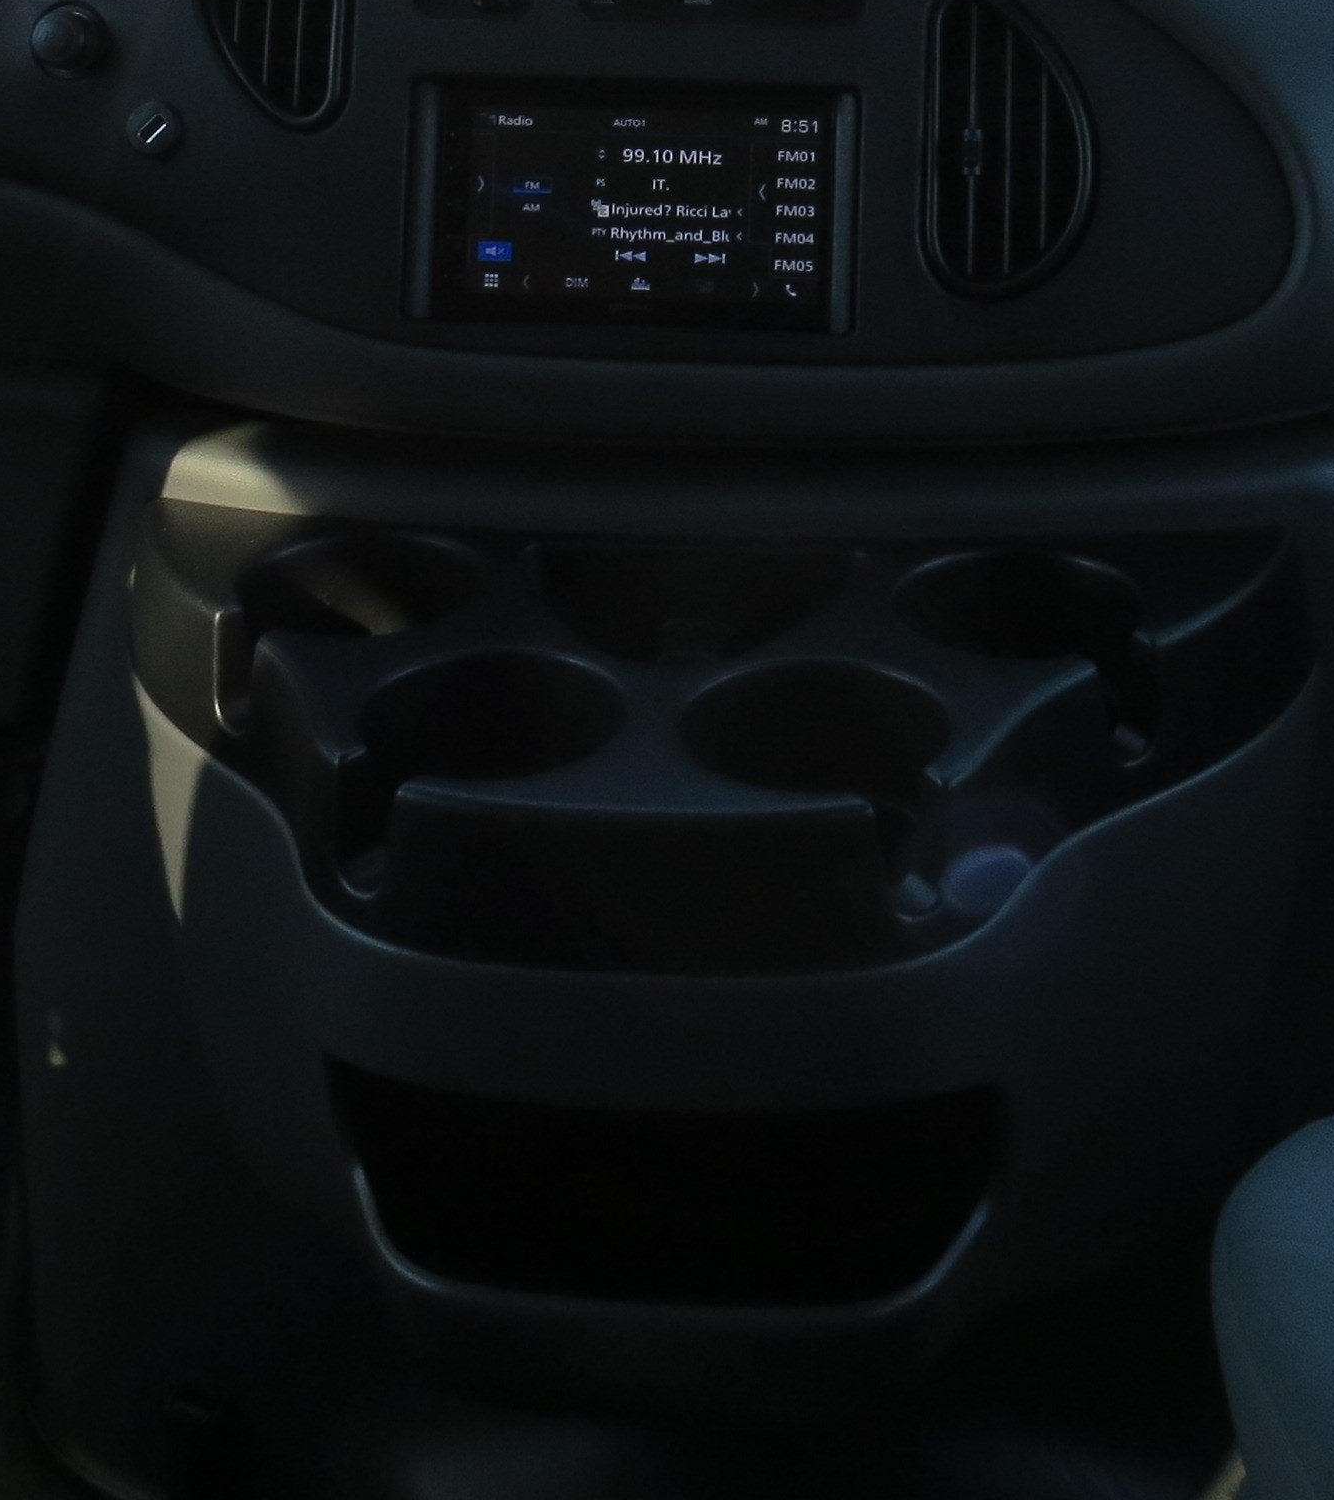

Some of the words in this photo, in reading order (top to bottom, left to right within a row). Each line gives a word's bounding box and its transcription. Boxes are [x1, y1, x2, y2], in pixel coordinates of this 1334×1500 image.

[498, 114, 534, 127] Radio
[780, 118, 820, 134] 8:51
[622, 148, 674, 164] 99.10
[679, 149, 724, 167] MHz
[777, 150, 817, 162] FM01
[776, 178, 816, 191] FM02
[522, 203, 541, 212] AM
[611, 202, 672, 219] Injured?
[676, 203, 708, 217] Ricci
[775, 204, 816, 217] FM03
[774, 231, 815, 245] FM04
[773, 260, 814, 272] FM05
[565, 277, 589, 289] DIM
